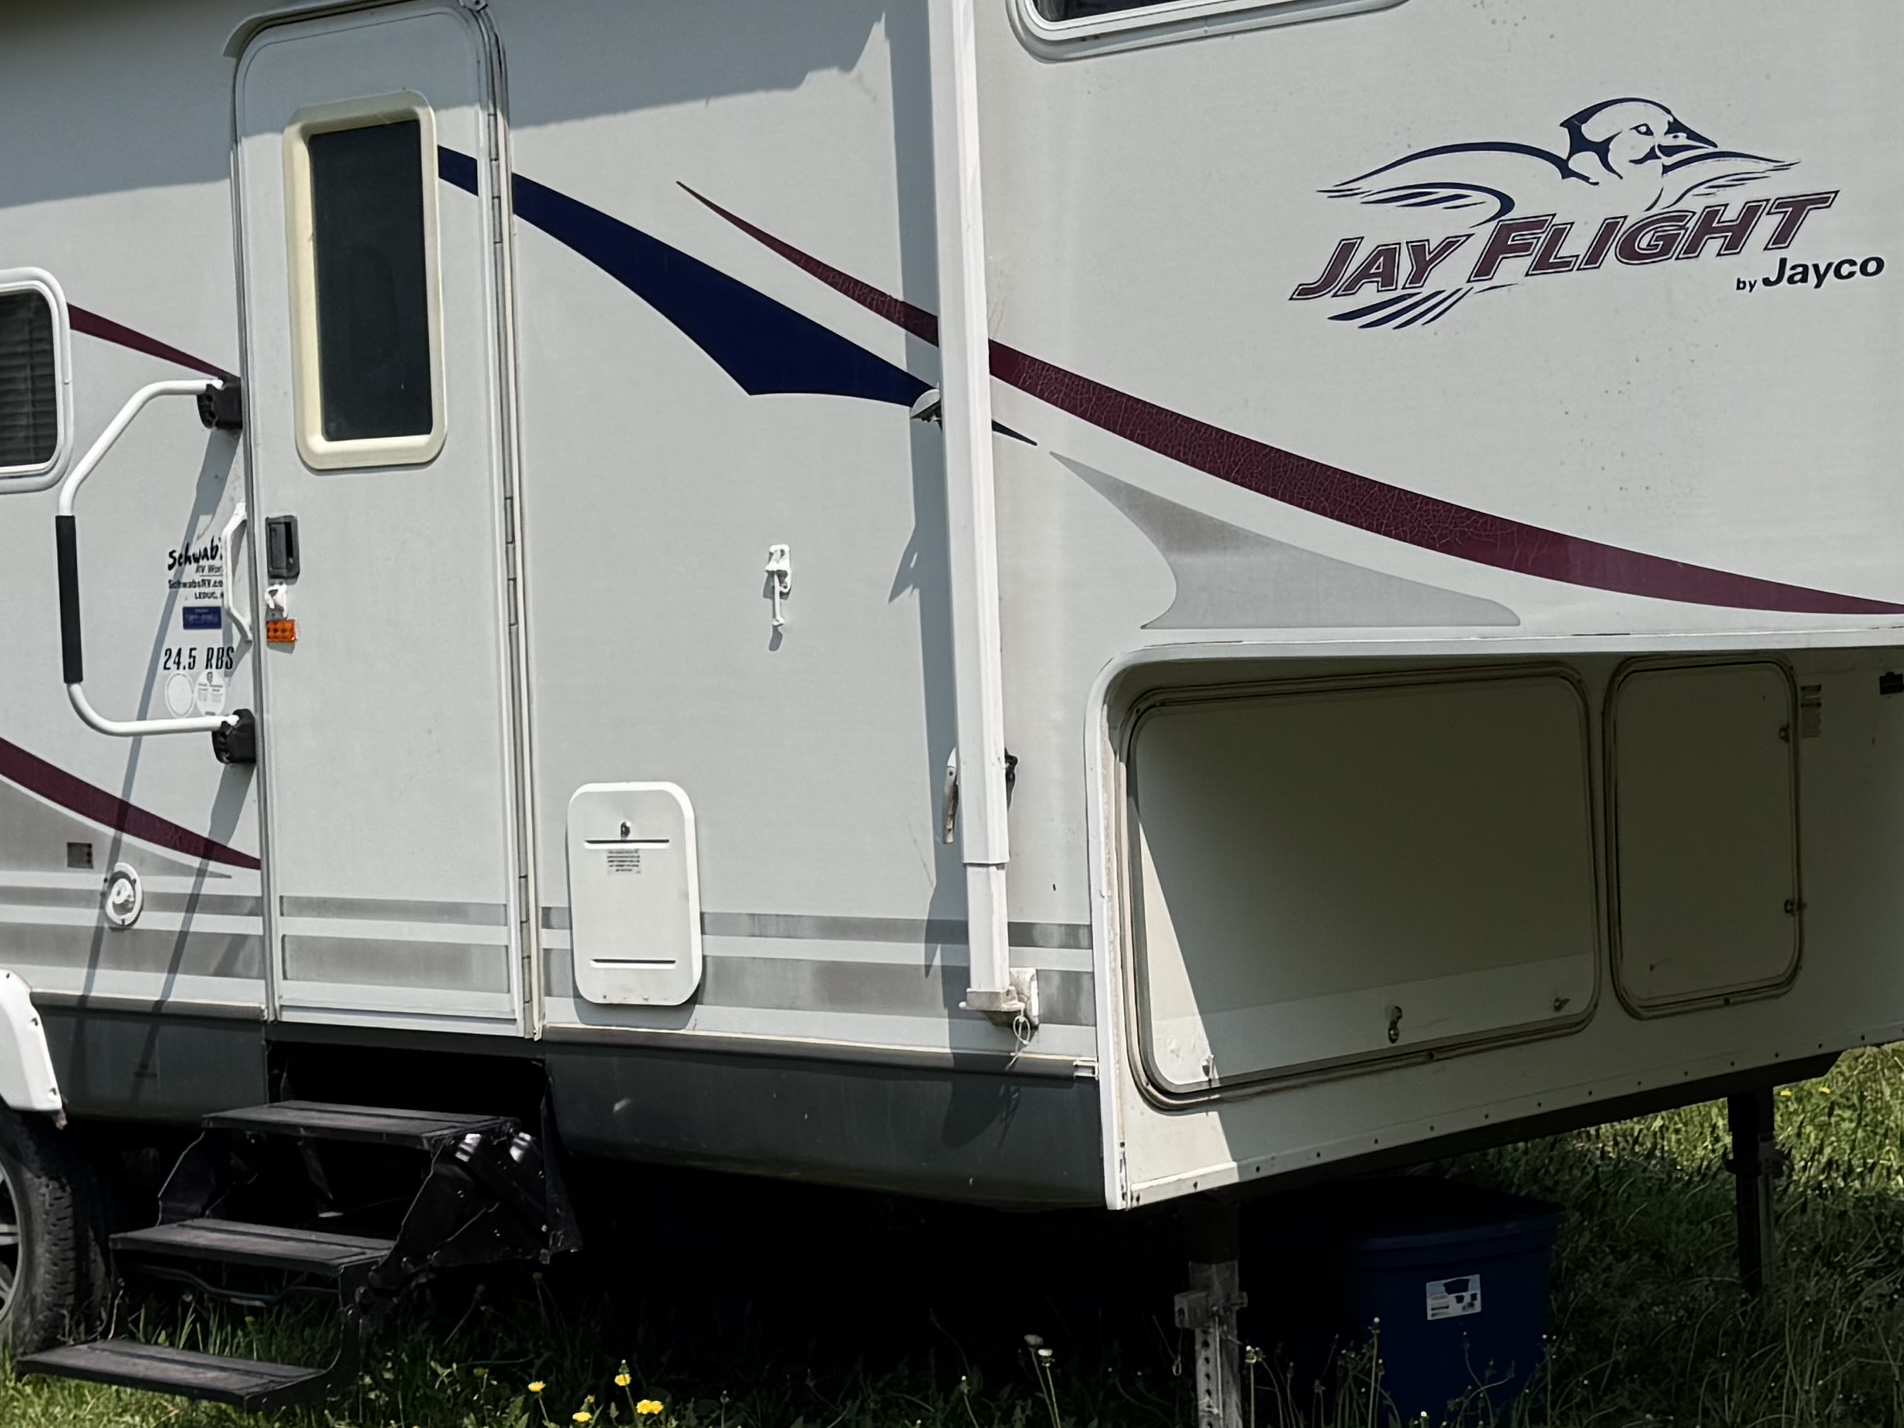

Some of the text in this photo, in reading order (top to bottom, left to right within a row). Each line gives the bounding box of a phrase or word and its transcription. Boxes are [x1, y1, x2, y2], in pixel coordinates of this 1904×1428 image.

[1288, 190, 1840, 300] JAY FLIGHT
[1736, 256, 1885, 293] by Jayco
[168, 578, 223, 589] SchwabsRV.co
[163, 646, 234, 670] 24.5 RBS
